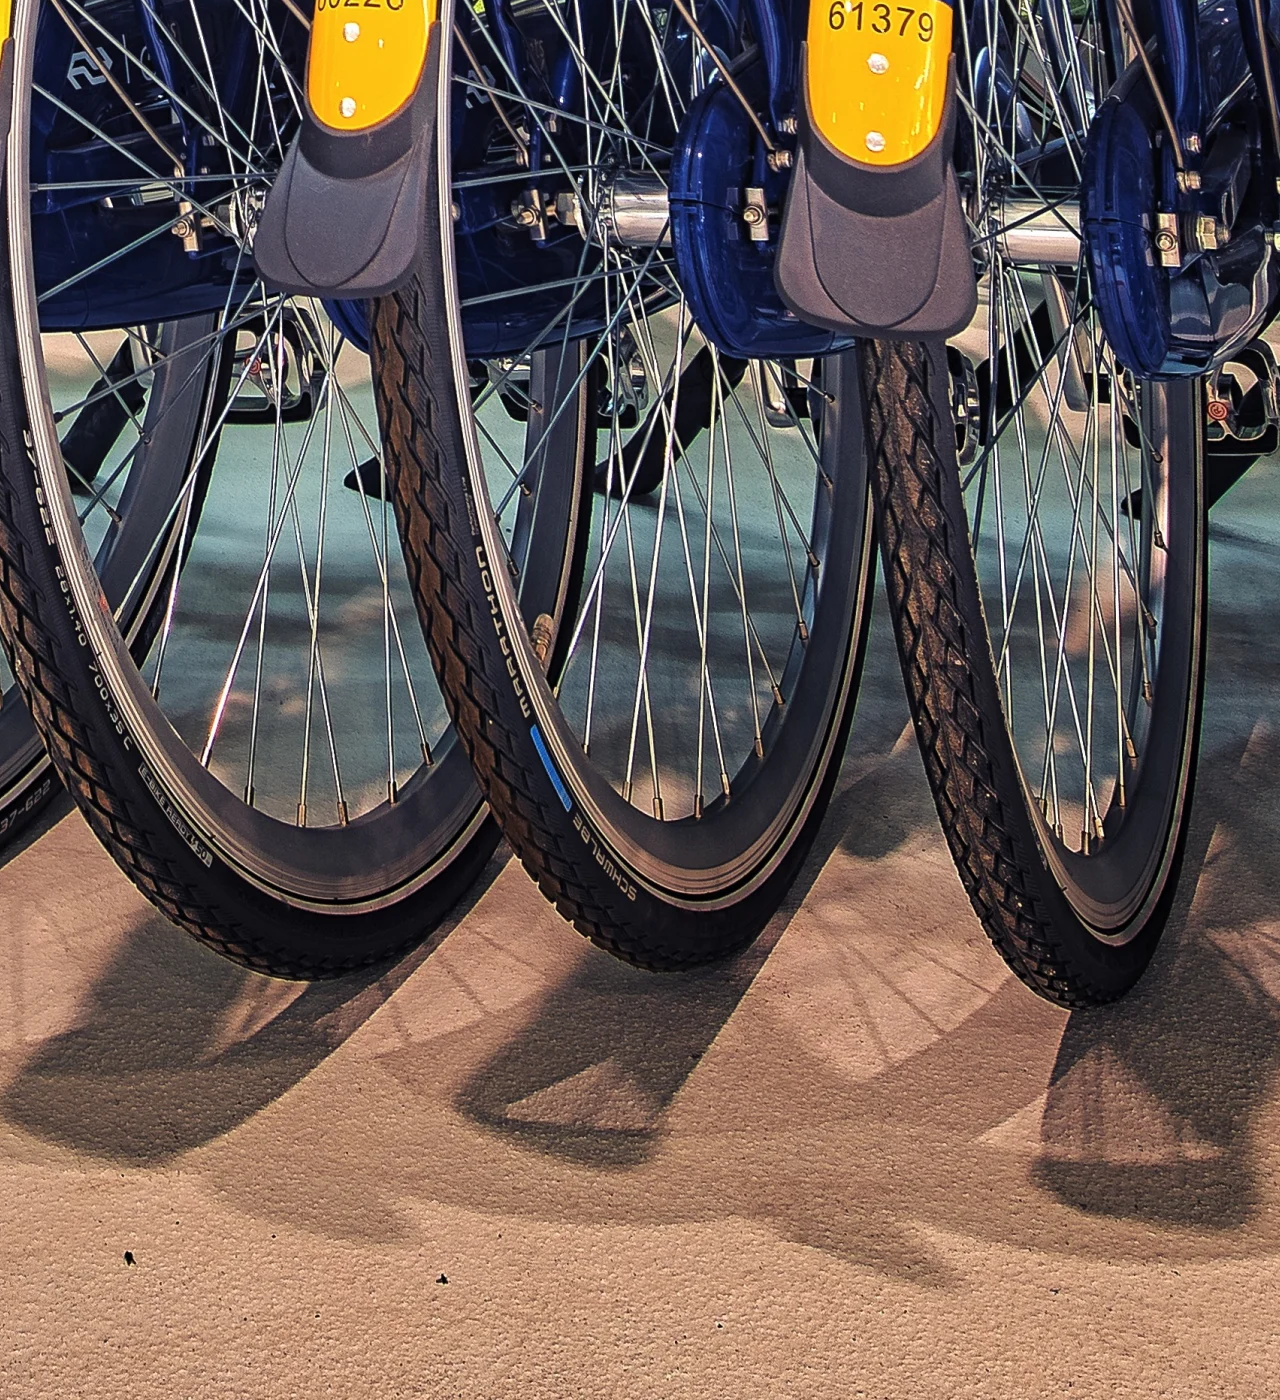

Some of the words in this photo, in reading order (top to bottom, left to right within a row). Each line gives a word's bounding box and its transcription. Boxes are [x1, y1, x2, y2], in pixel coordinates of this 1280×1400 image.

[828, 0, 934, 43] 61379
[22, 429, 57, 547] 37-622
[53, 563, 88, 647] 28x1.40
[474, 545, 532, 720] MARATHON
[0, 779, 51, 835] 37-622
[573, 809, 639, 902] SCHWALBE
